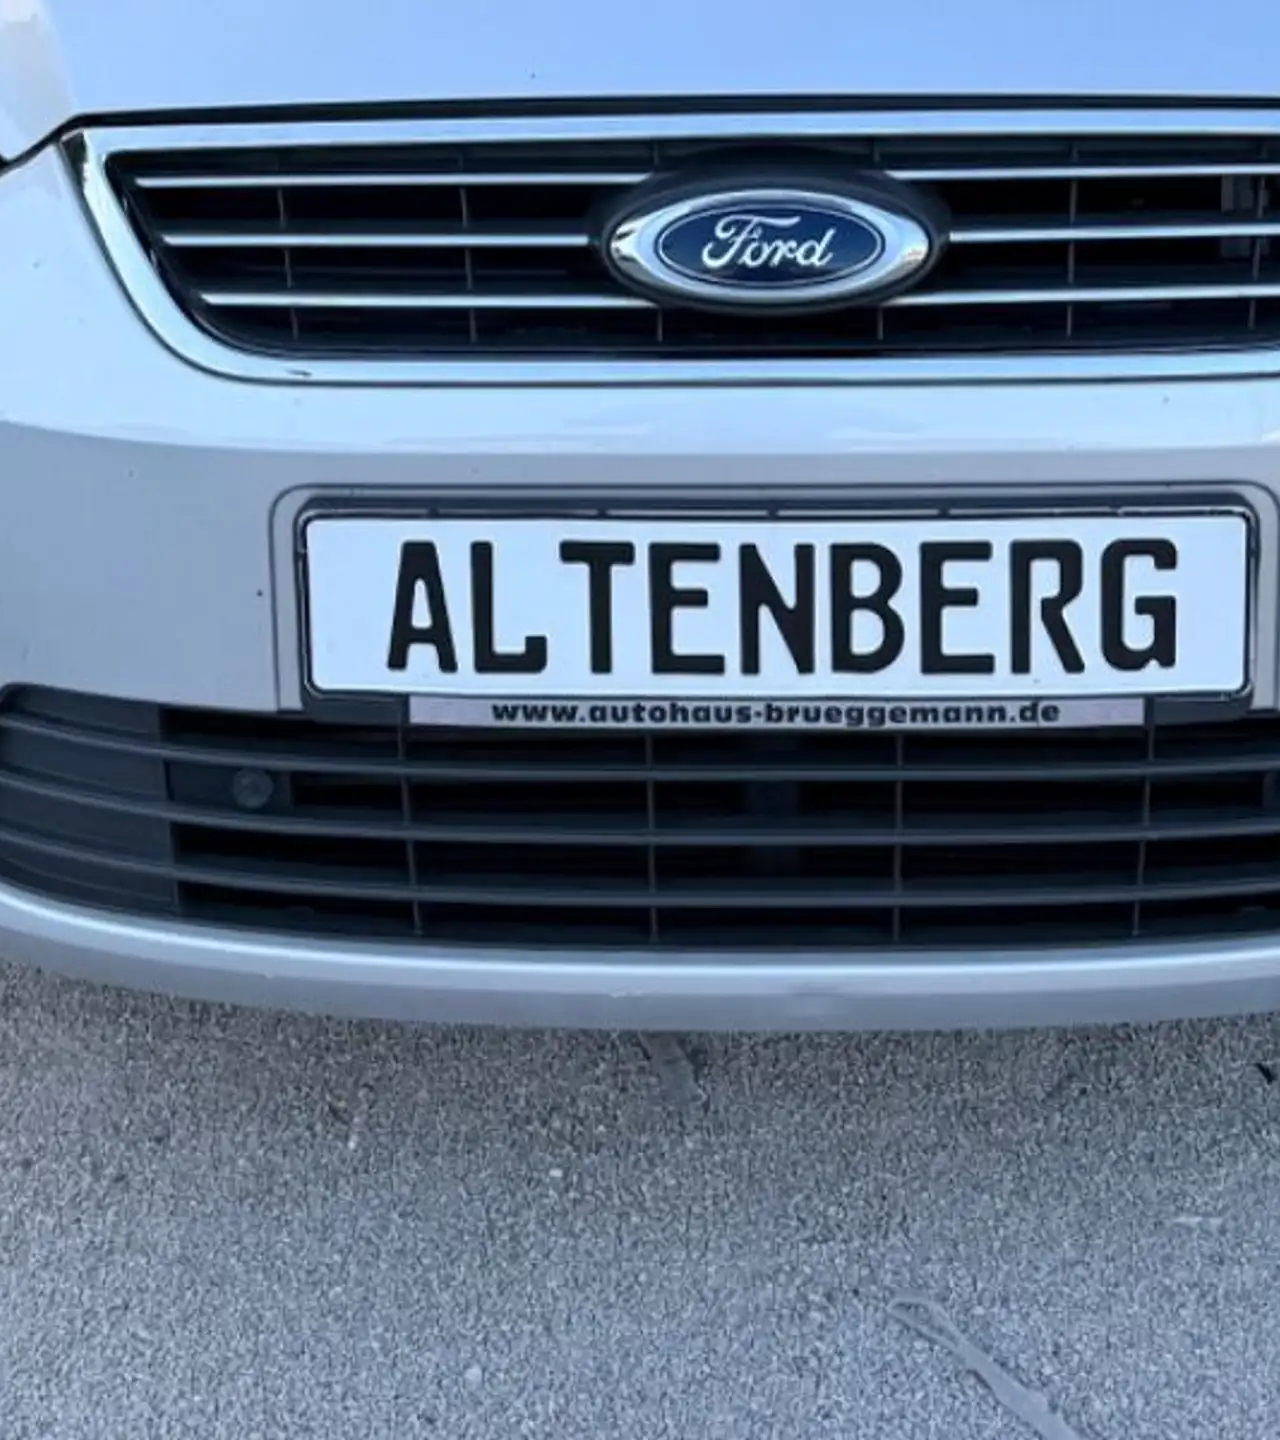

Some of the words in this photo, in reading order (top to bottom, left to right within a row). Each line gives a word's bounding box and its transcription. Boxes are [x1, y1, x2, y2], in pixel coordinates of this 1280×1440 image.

[701, 213, 837, 268] Ford
[387, 539, 1178, 675] ALTENBERG
[491, 702, 1060, 728] www.autohaus-brueggemann.de
